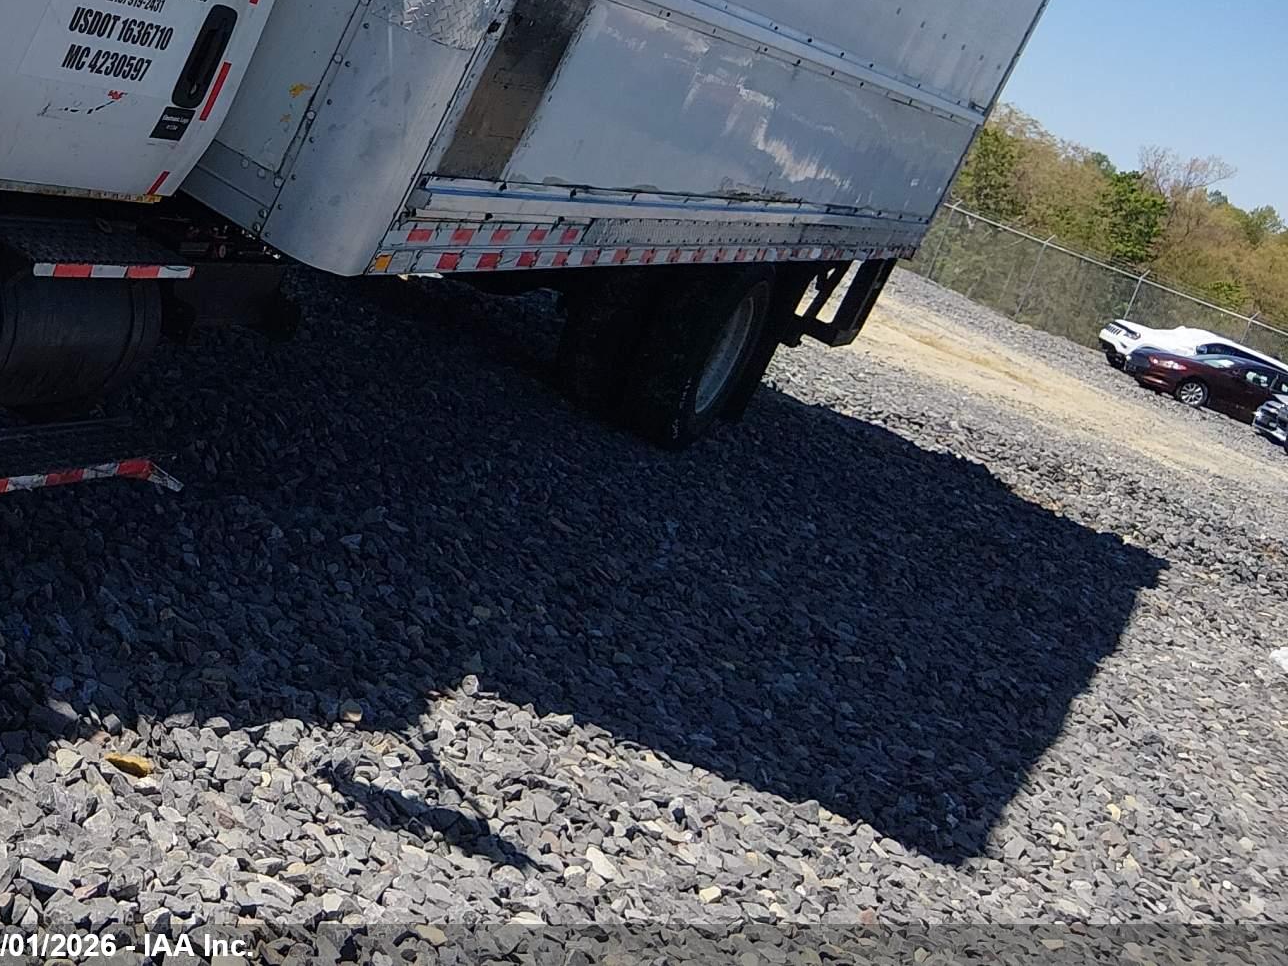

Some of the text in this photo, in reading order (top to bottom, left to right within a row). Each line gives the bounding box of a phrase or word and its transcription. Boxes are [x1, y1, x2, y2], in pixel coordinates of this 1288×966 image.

[68, 6, 174, 51] USDOT 1636710
[61, 44, 153, 82] MC 4230597
